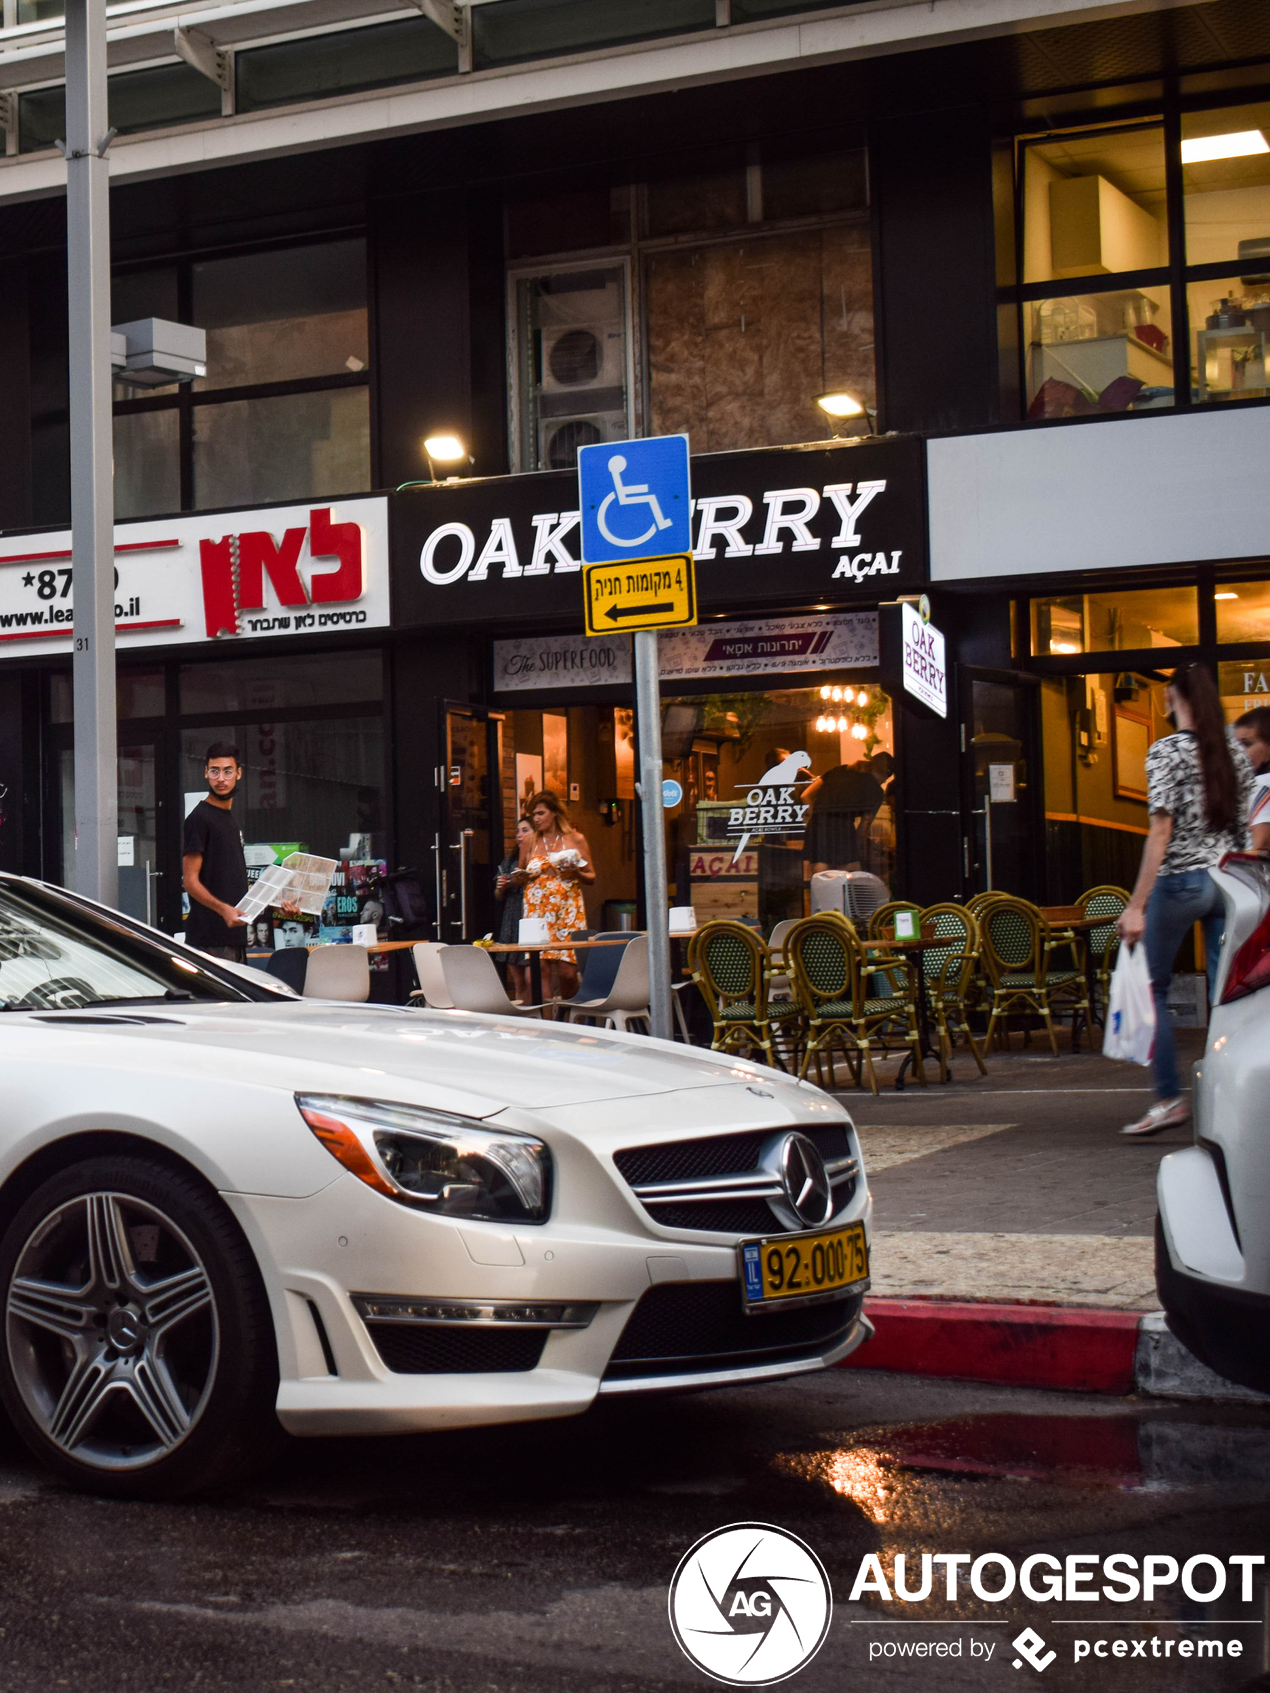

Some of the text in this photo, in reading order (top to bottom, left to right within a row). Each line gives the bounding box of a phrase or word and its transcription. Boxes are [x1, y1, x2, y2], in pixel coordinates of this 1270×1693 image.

[832, 551, 903, 583] AÇAI
[595, 577, 622, 601] חניה
[626, 571, 671, 597] מקומות
[247, 610, 367, 632] כרטיסים לאן שתבחר
[76, 637, 89, 651] 31
[758, 639, 803, 653] יתרונות
[912, 620, 936, 661] OAK
[504, 647, 616, 676] The SUPERFOOD
[905, 641, 945, 694] BERRY
[746, 787, 796, 806] OAK
[728, 805, 810, 825] BERRY
[691, 856, 754, 878] AÇAI
[337, 897, 358, 913] EROS
